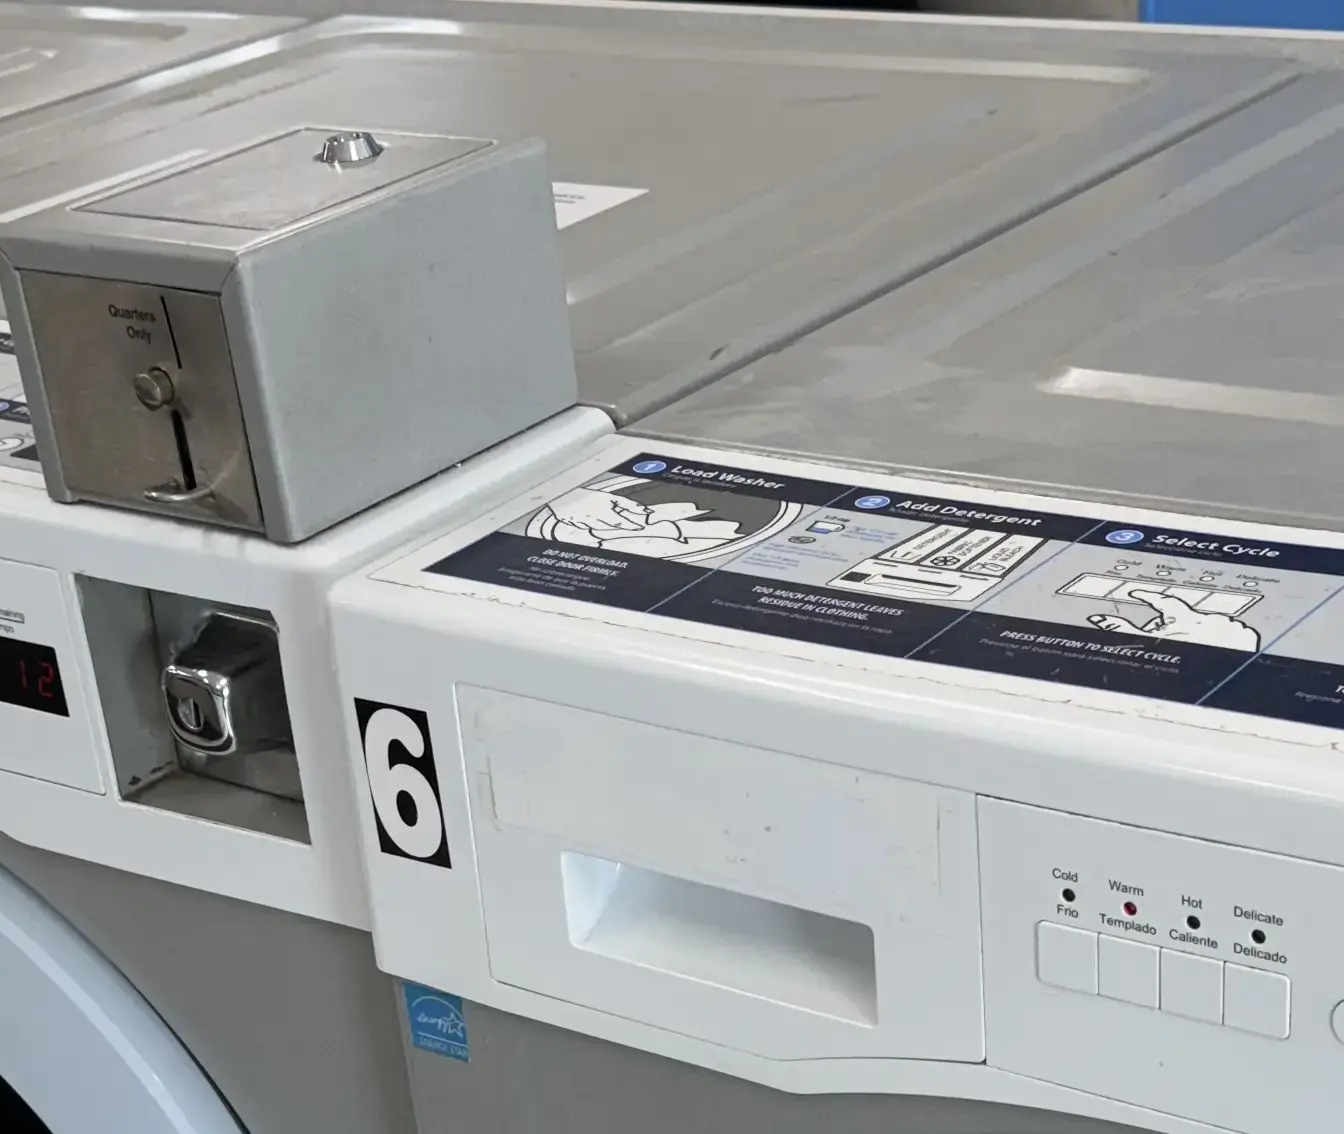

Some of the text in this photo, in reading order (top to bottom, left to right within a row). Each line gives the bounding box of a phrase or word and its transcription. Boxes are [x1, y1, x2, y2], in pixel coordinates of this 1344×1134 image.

[108, 304, 156, 322] Quarters
[126, 325, 152, 345] Only
[670, 465, 718, 478] Load
[715, 472, 788, 489] Washer
[897, 499, 939, 511] Add
[938, 506, 1041, 528] Detergent
[557, 551, 579, 559] NOT
[1152, 533, 1219, 550] Select
[1221, 542, 1280, 559] Cycle
[525, 555, 557, 565] CLOSE
[555, 560, 585, 570] DOOR
[751, 585, 904, 616] TOO MUCH DETERGENT LEAVES
[758, 596, 872, 620] RESIDUE IN CLOTHING.
[1000, 630, 1183, 663] PRESS BUTTON TO SELECT CYCLE.
[19, 660, 55, 698] 12
[362, 705, 445, 861] 6
[1052, 867, 1079, 883] Cold
[1108, 879, 1145, 897] Warm
[1056, 904, 1079, 919] Frio
[1181, 894, 1203, 910] Hot
[1099, 913, 1157, 936] Templado
[1233, 906, 1284, 927] Delicate
[1169, 929, 1219, 949] Caliente
[1233, 943, 1288, 965] Delicado
